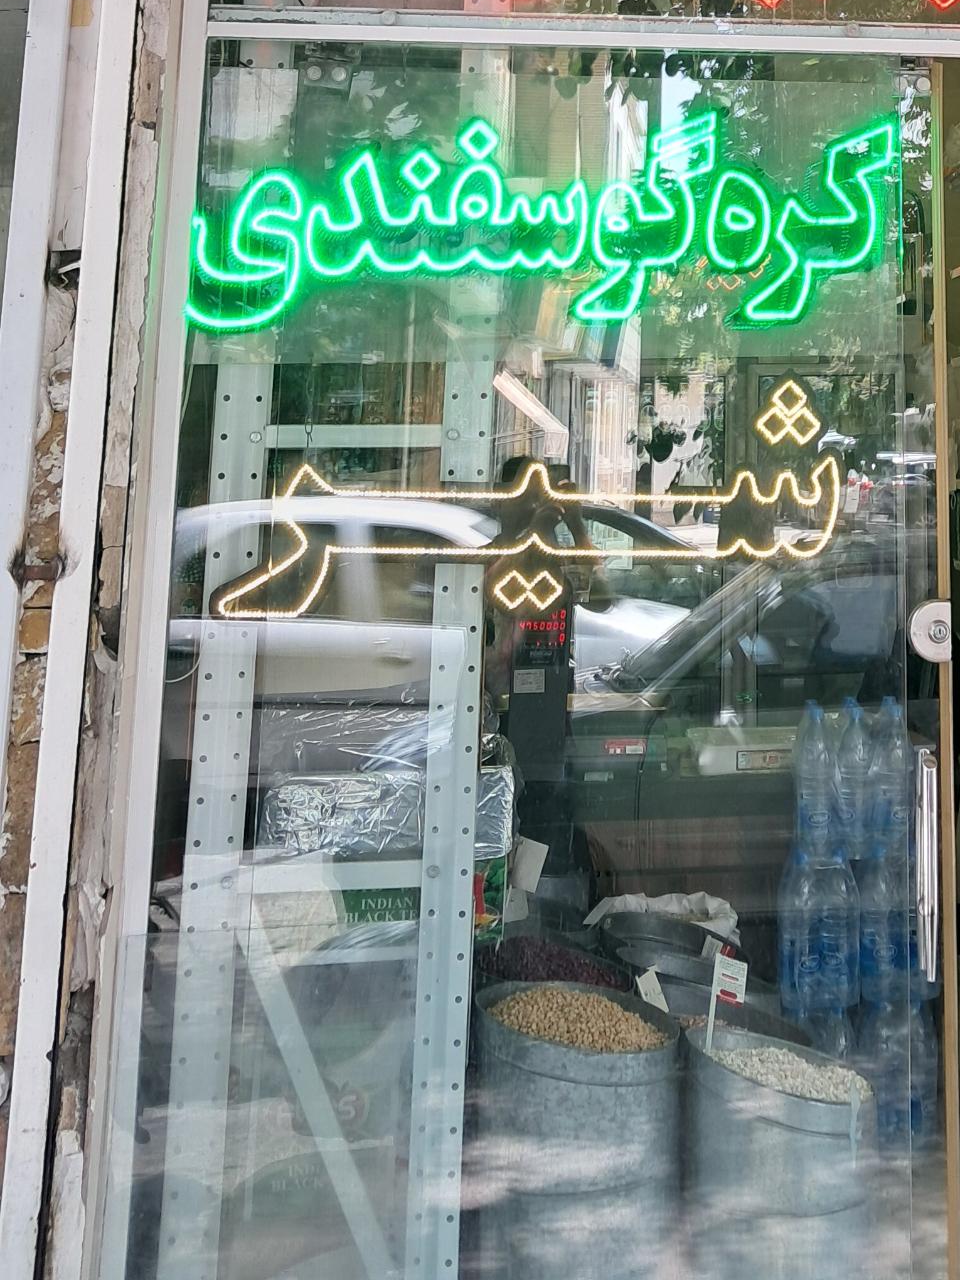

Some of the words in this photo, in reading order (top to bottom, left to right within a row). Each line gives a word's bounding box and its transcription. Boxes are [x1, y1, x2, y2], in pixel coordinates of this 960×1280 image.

[184, 111, 717, 330] گوسفندی
[703, 119, 897, 320] کره
[217, 380, 841, 616] شیر
[344, 909, 394, 923] BLACK
[399, 908, 418, 921] TE
[361, 897, 414, 910] INDIAN
